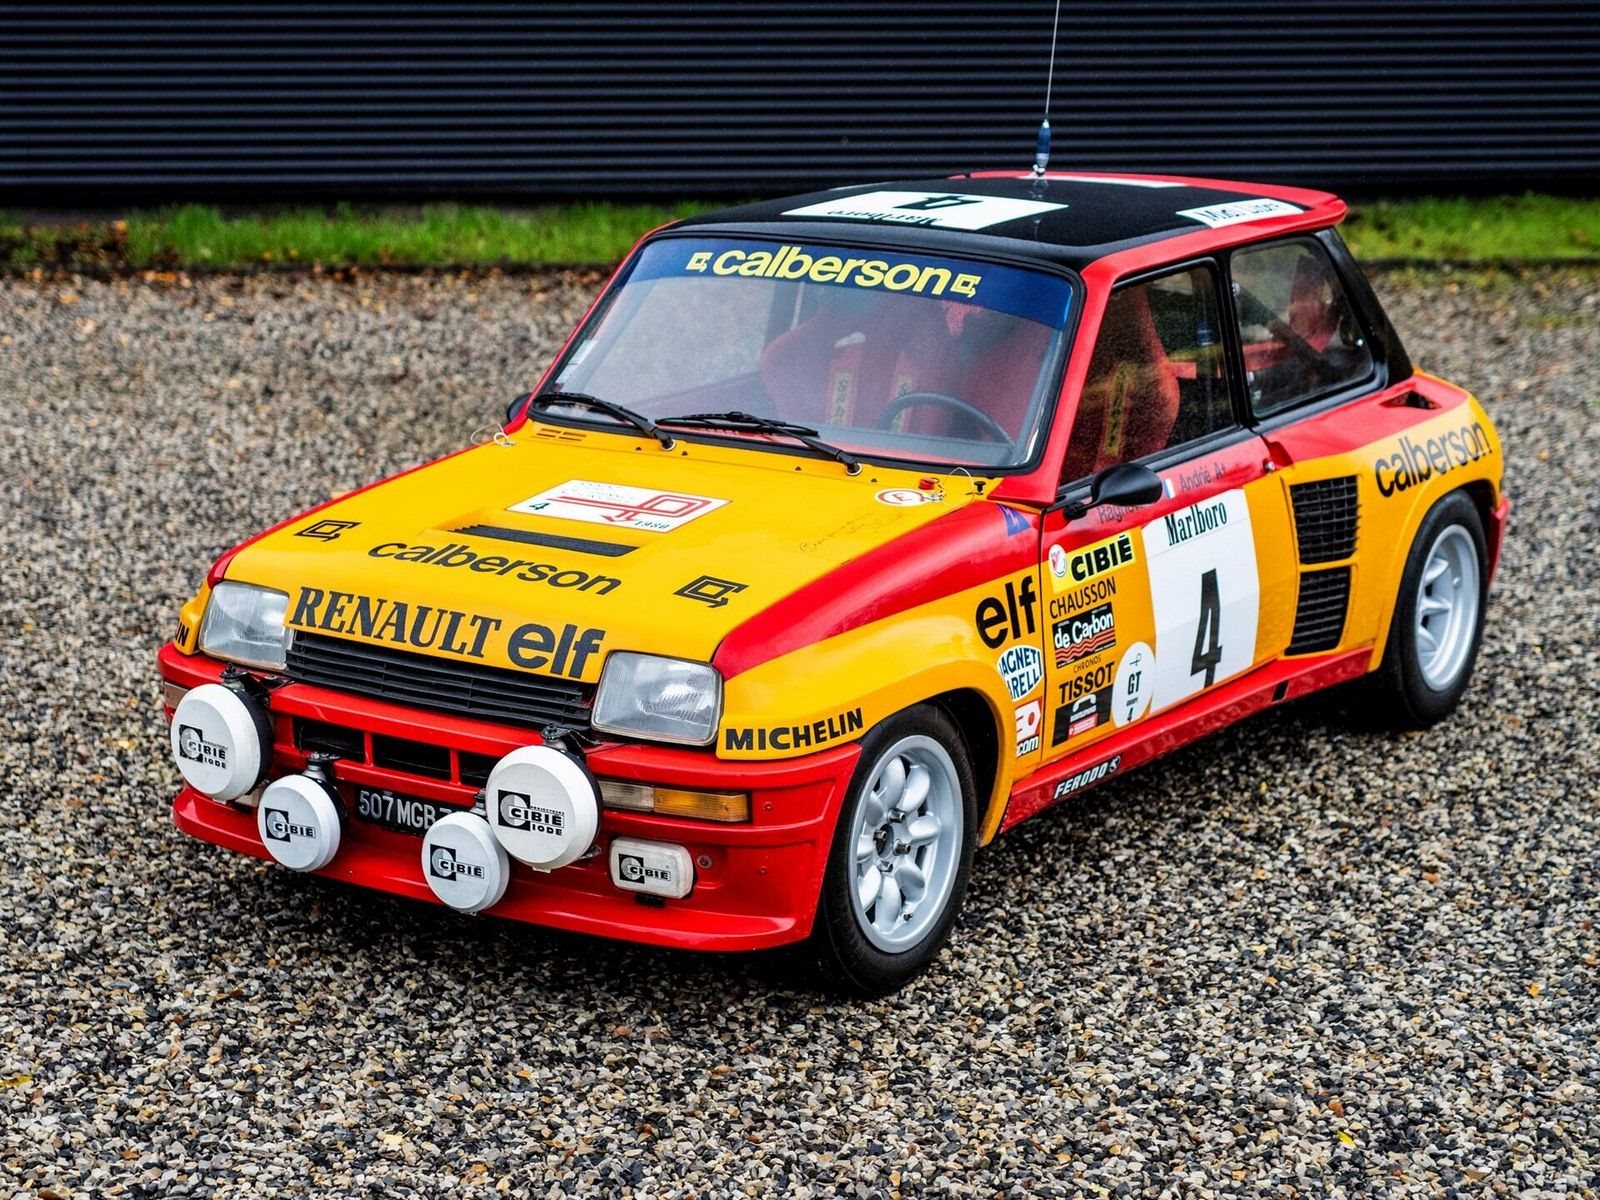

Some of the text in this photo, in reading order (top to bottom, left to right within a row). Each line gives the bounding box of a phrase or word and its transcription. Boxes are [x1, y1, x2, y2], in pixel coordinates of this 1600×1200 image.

[712, 245, 952, 296] calberson
[1375, 422, 1493, 497] calberson
[528, 502, 551, 510] 4
[1164, 502, 1227, 546] Marlboro
[367, 543, 622, 595] calberson
[975, 575, 1037, 649] elf
[1049, 576, 1117, 619] CHAUSSON
[288, 586, 606, 680] RENAULT elf
[1054, 627, 1071, 649] de
[1072, 612, 1114, 643] Carbon
[1190, 568, 1223, 689] 4
[999, 648, 1042, 676] AGNETI
[1059, 661, 1115, 704] TISSOT
[1127, 670, 1142, 695] GT
[725, 707, 863, 750] MICHELIN
[204, 757, 226, 769] IODE
[1053, 762, 1109, 799] FERODO
[532, 824, 562, 836] IODE
